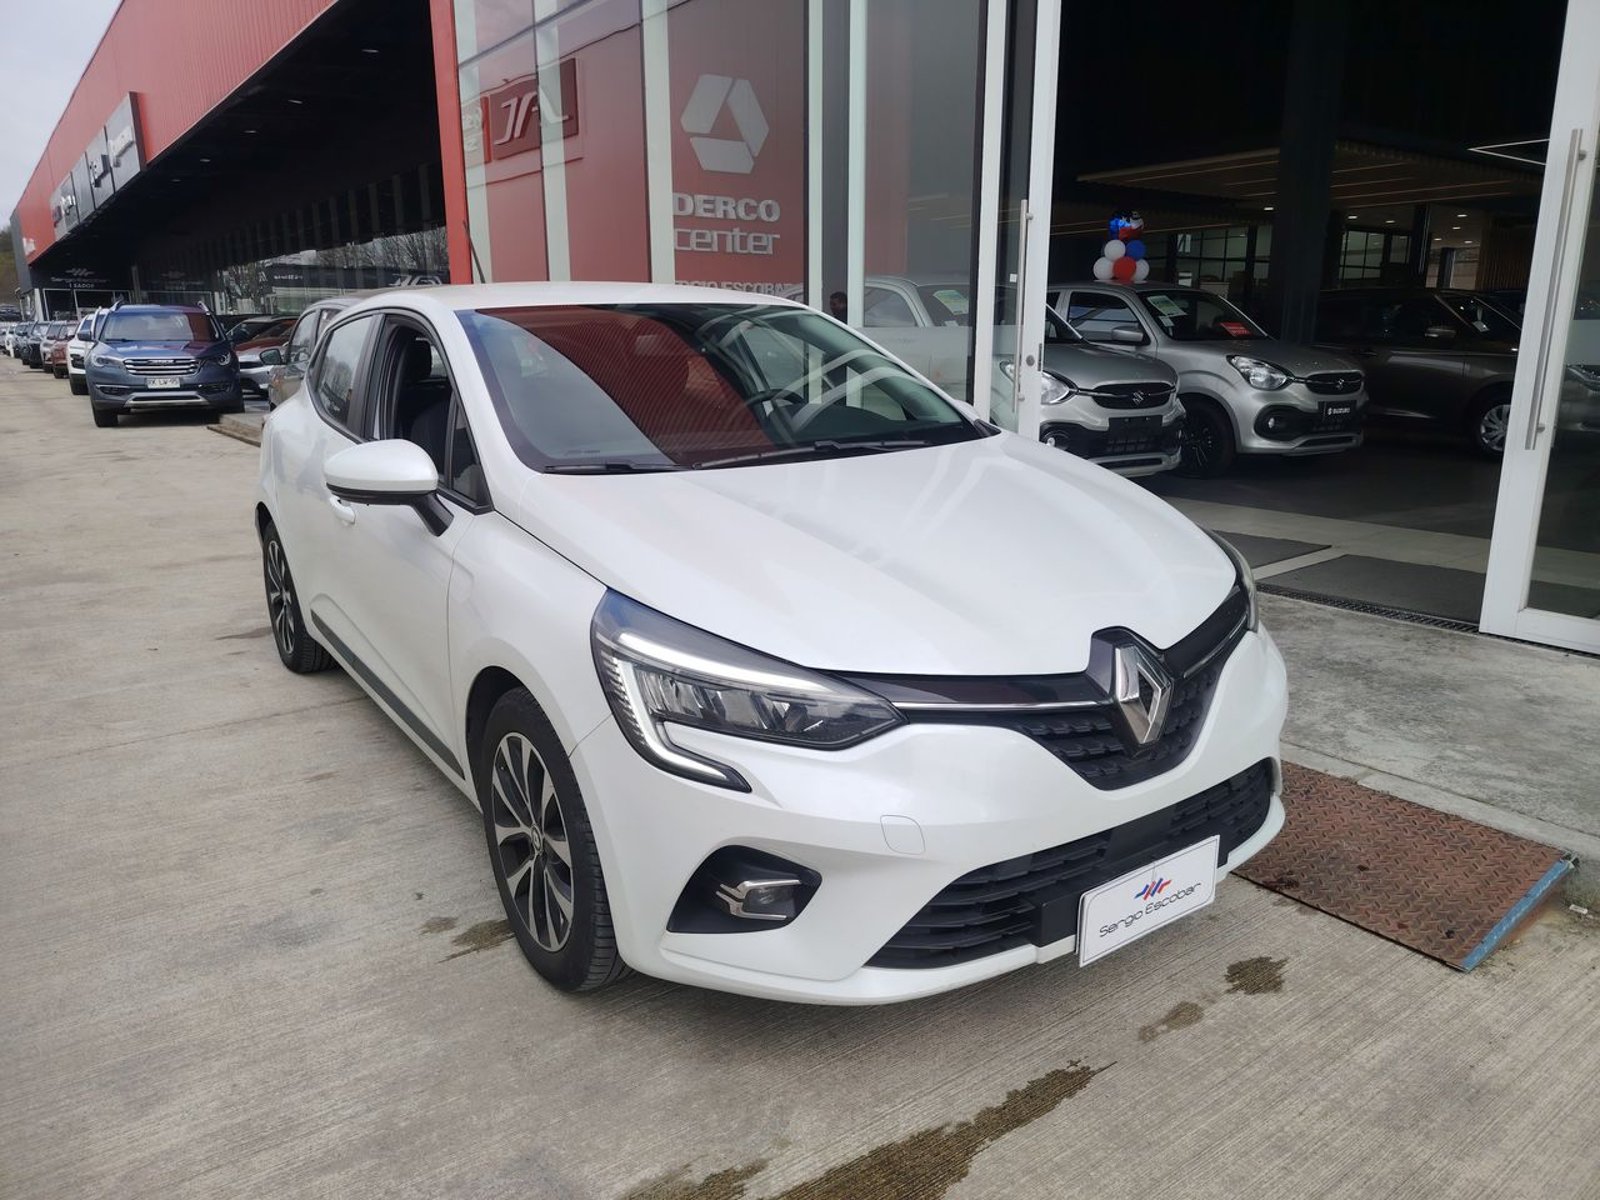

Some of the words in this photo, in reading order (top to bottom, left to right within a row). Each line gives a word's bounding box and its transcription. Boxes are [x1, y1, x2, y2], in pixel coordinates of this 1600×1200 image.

[672, 192, 780, 222] DERCO
[674, 227, 780, 254] center
[1145, 882, 1202, 915] Escobar
